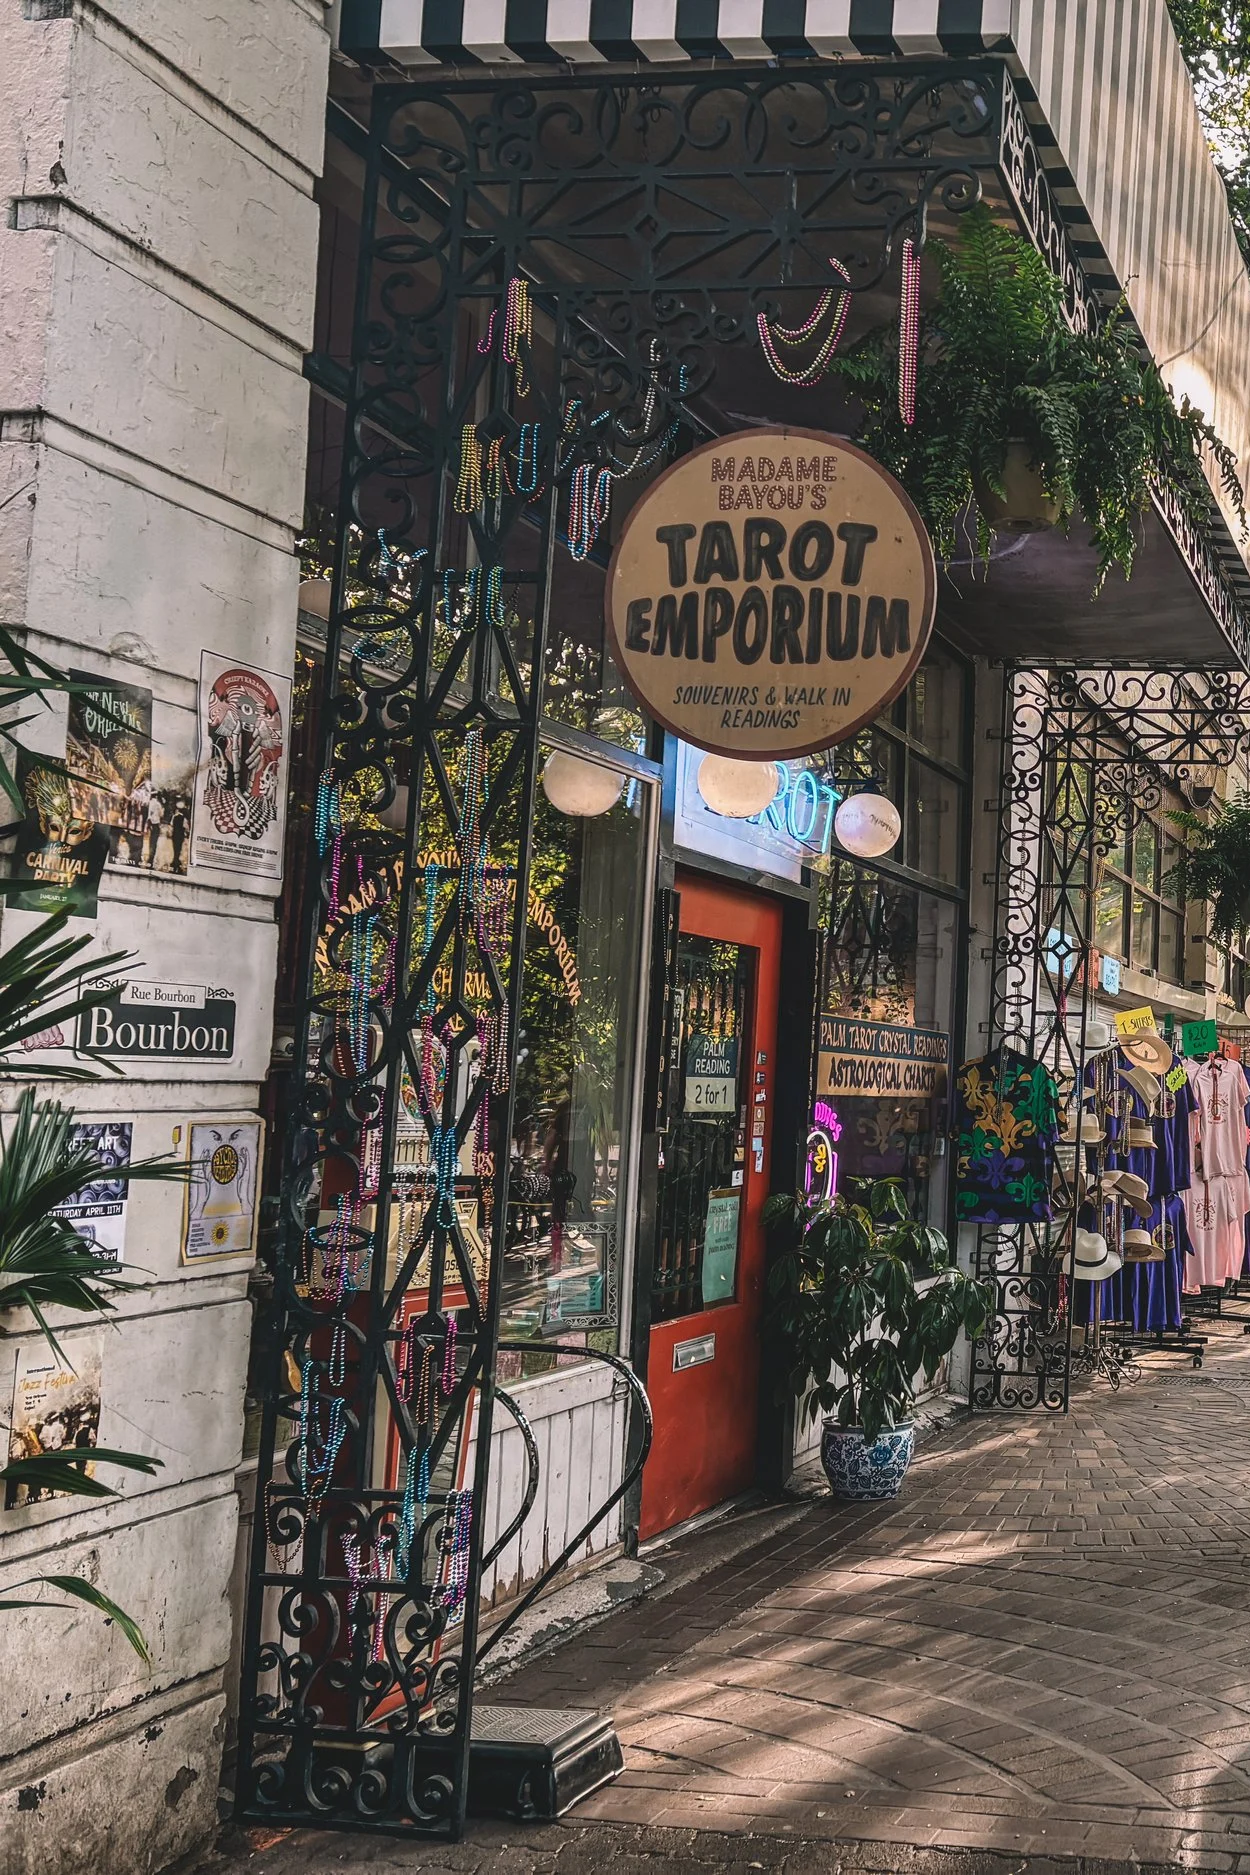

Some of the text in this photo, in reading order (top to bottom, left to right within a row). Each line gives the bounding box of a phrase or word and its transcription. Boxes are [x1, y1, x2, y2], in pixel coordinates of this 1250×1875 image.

[711, 456, 838, 482] MADAME
[718, 484, 827, 511] BAYOU'S
[656, 517, 878, 588] TAROT
[624, 584, 911, 666] EMPORIUM
[673, 686, 851, 707] SOUVENIRS & WALK IN
[721, 709, 800, 730] READINGS
[26, 851, 89, 875] CARNIVAL
[34, 868, 76, 888] PARTY
[131, 986, 196, 1003] Rue Bourbon
[86, 1006, 229, 1052] Bourbon
[1188, 1025, 1208, 1041] $20
[703, 1042, 725, 1058] PALM
[821, 1021, 947, 1061] PALM TAROT CRYSTAL READINGS
[695, 1059, 730, 1074] READING
[829, 1057, 936, 1094] ASTROLOGICAL CHARTS
[695, 1083, 728, 1104] 2 for 1
[97, 1136, 120, 1151] ART
[85, 1206, 105, 1217] APRIL
